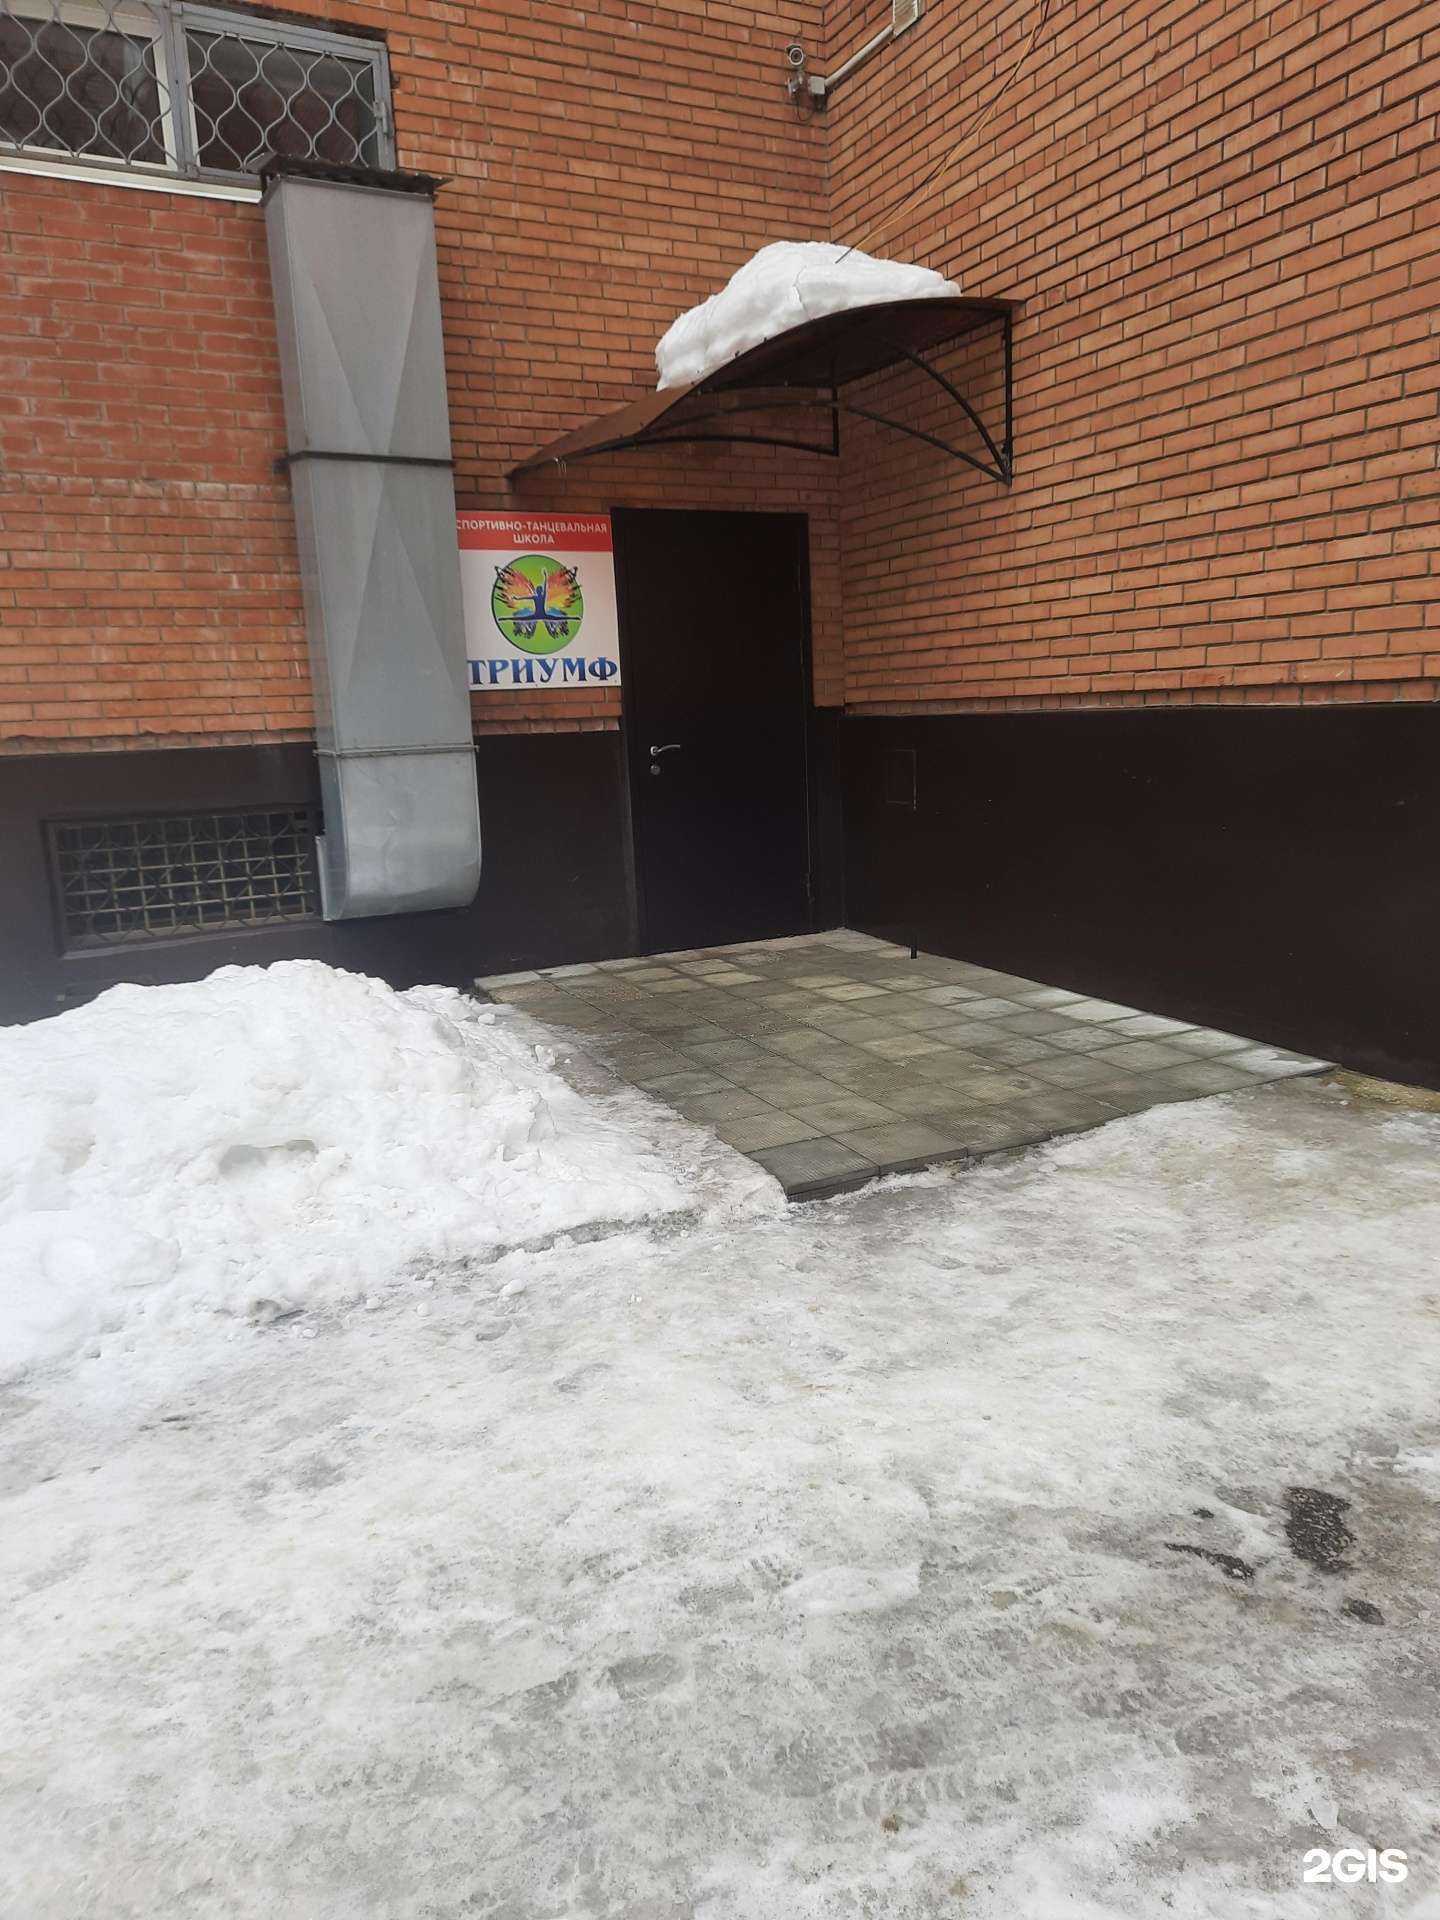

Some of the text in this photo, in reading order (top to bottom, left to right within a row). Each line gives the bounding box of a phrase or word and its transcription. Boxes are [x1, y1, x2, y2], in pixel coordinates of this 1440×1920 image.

[456, 519, 607, 534] СПОРТИВНО-ТАНЦЕВАЛЬНАЯ
[513, 534, 555, 544] ШКОЛА
[467, 657, 618, 685] ТРИУМФ
